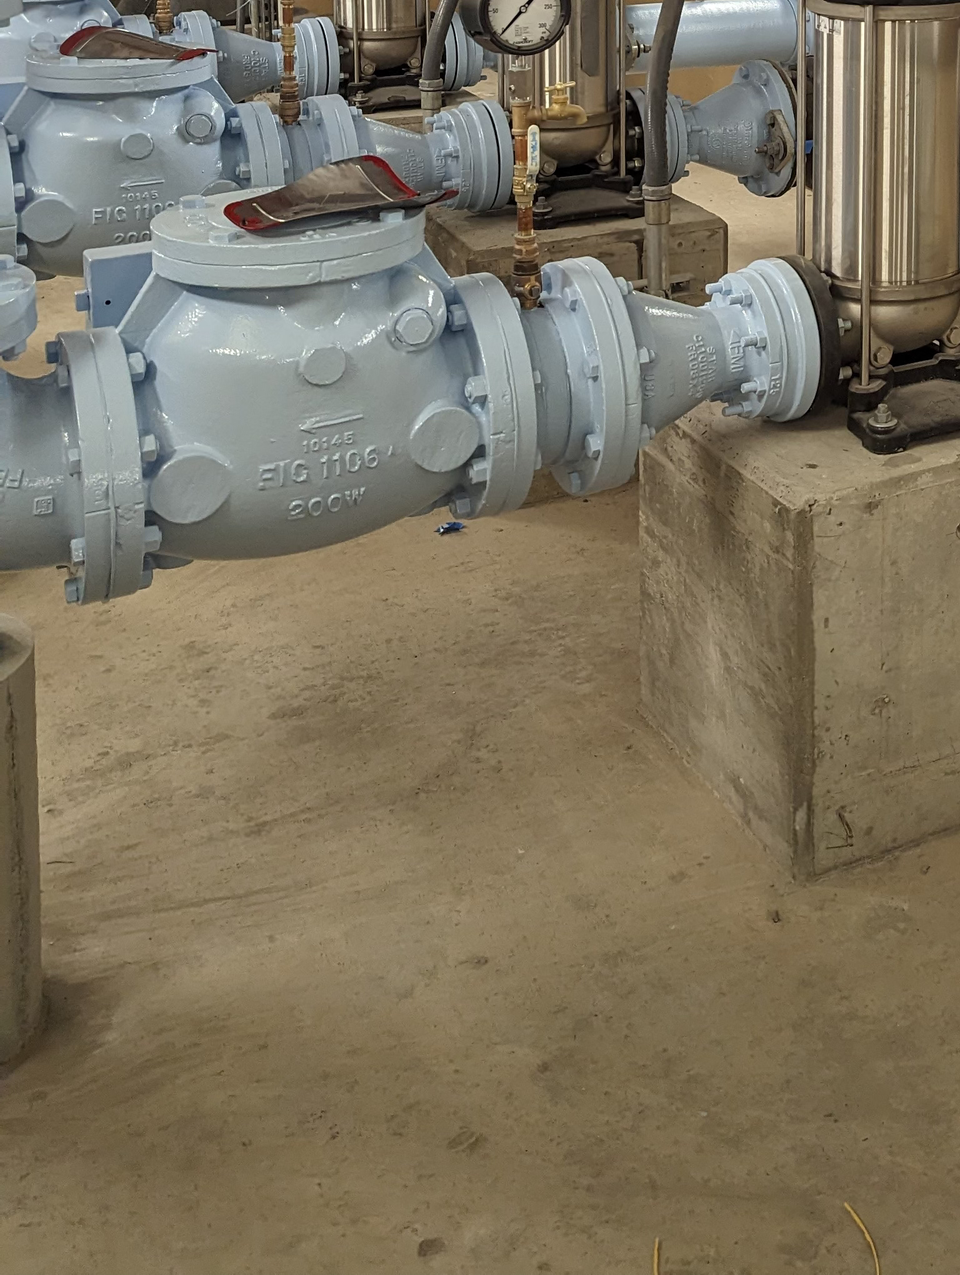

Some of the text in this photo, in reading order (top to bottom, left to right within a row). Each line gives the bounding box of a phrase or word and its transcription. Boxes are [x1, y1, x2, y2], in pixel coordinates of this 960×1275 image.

[92, 206, 127, 225] FIG
[302, 430, 354, 454] 10145
[258, 444, 379, 491] FIG 1106
[287, 486, 366, 521] 200W
